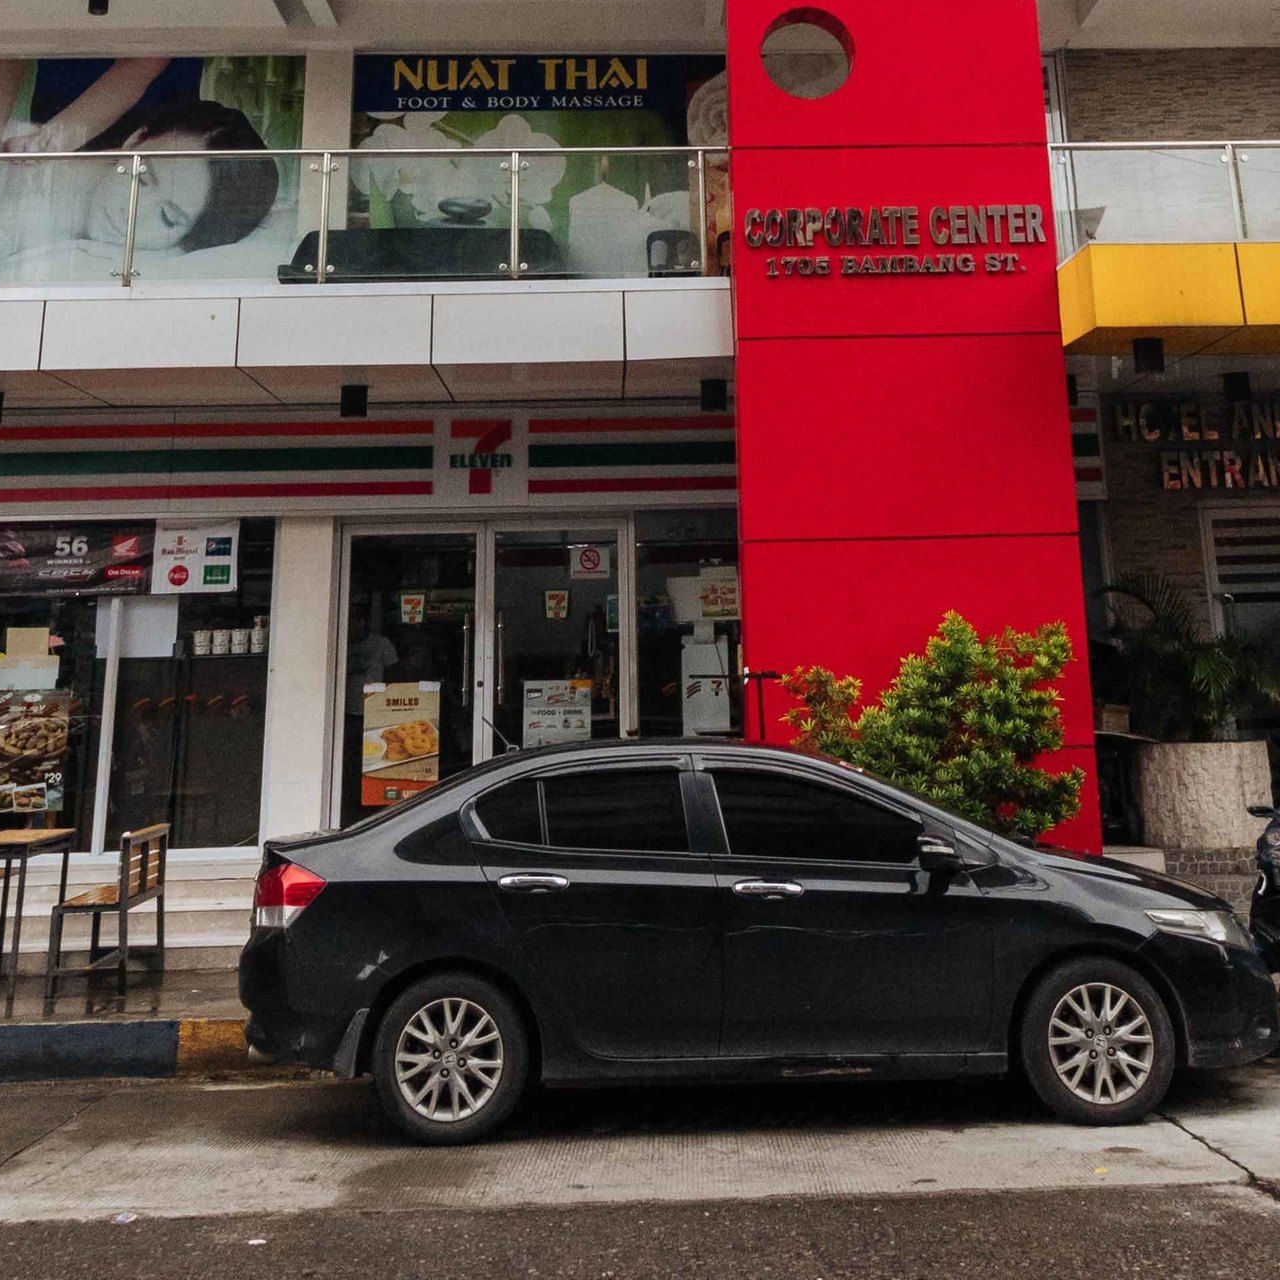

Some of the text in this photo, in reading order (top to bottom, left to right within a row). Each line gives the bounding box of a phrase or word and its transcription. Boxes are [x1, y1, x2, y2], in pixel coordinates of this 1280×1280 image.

[392, 56, 649, 93] NUAT THAI
[396, 94, 644, 110] FOOT & BODY MASSAGE
[744, 204, 1048, 248] CORPORATE CENTER
[765, 252, 1028, 277] 1705 BAMBANG ST.
[450, 419, 512, 495] 7
[53, 534, 89, 557] 56
[385, 696, 420, 708] SMILES
